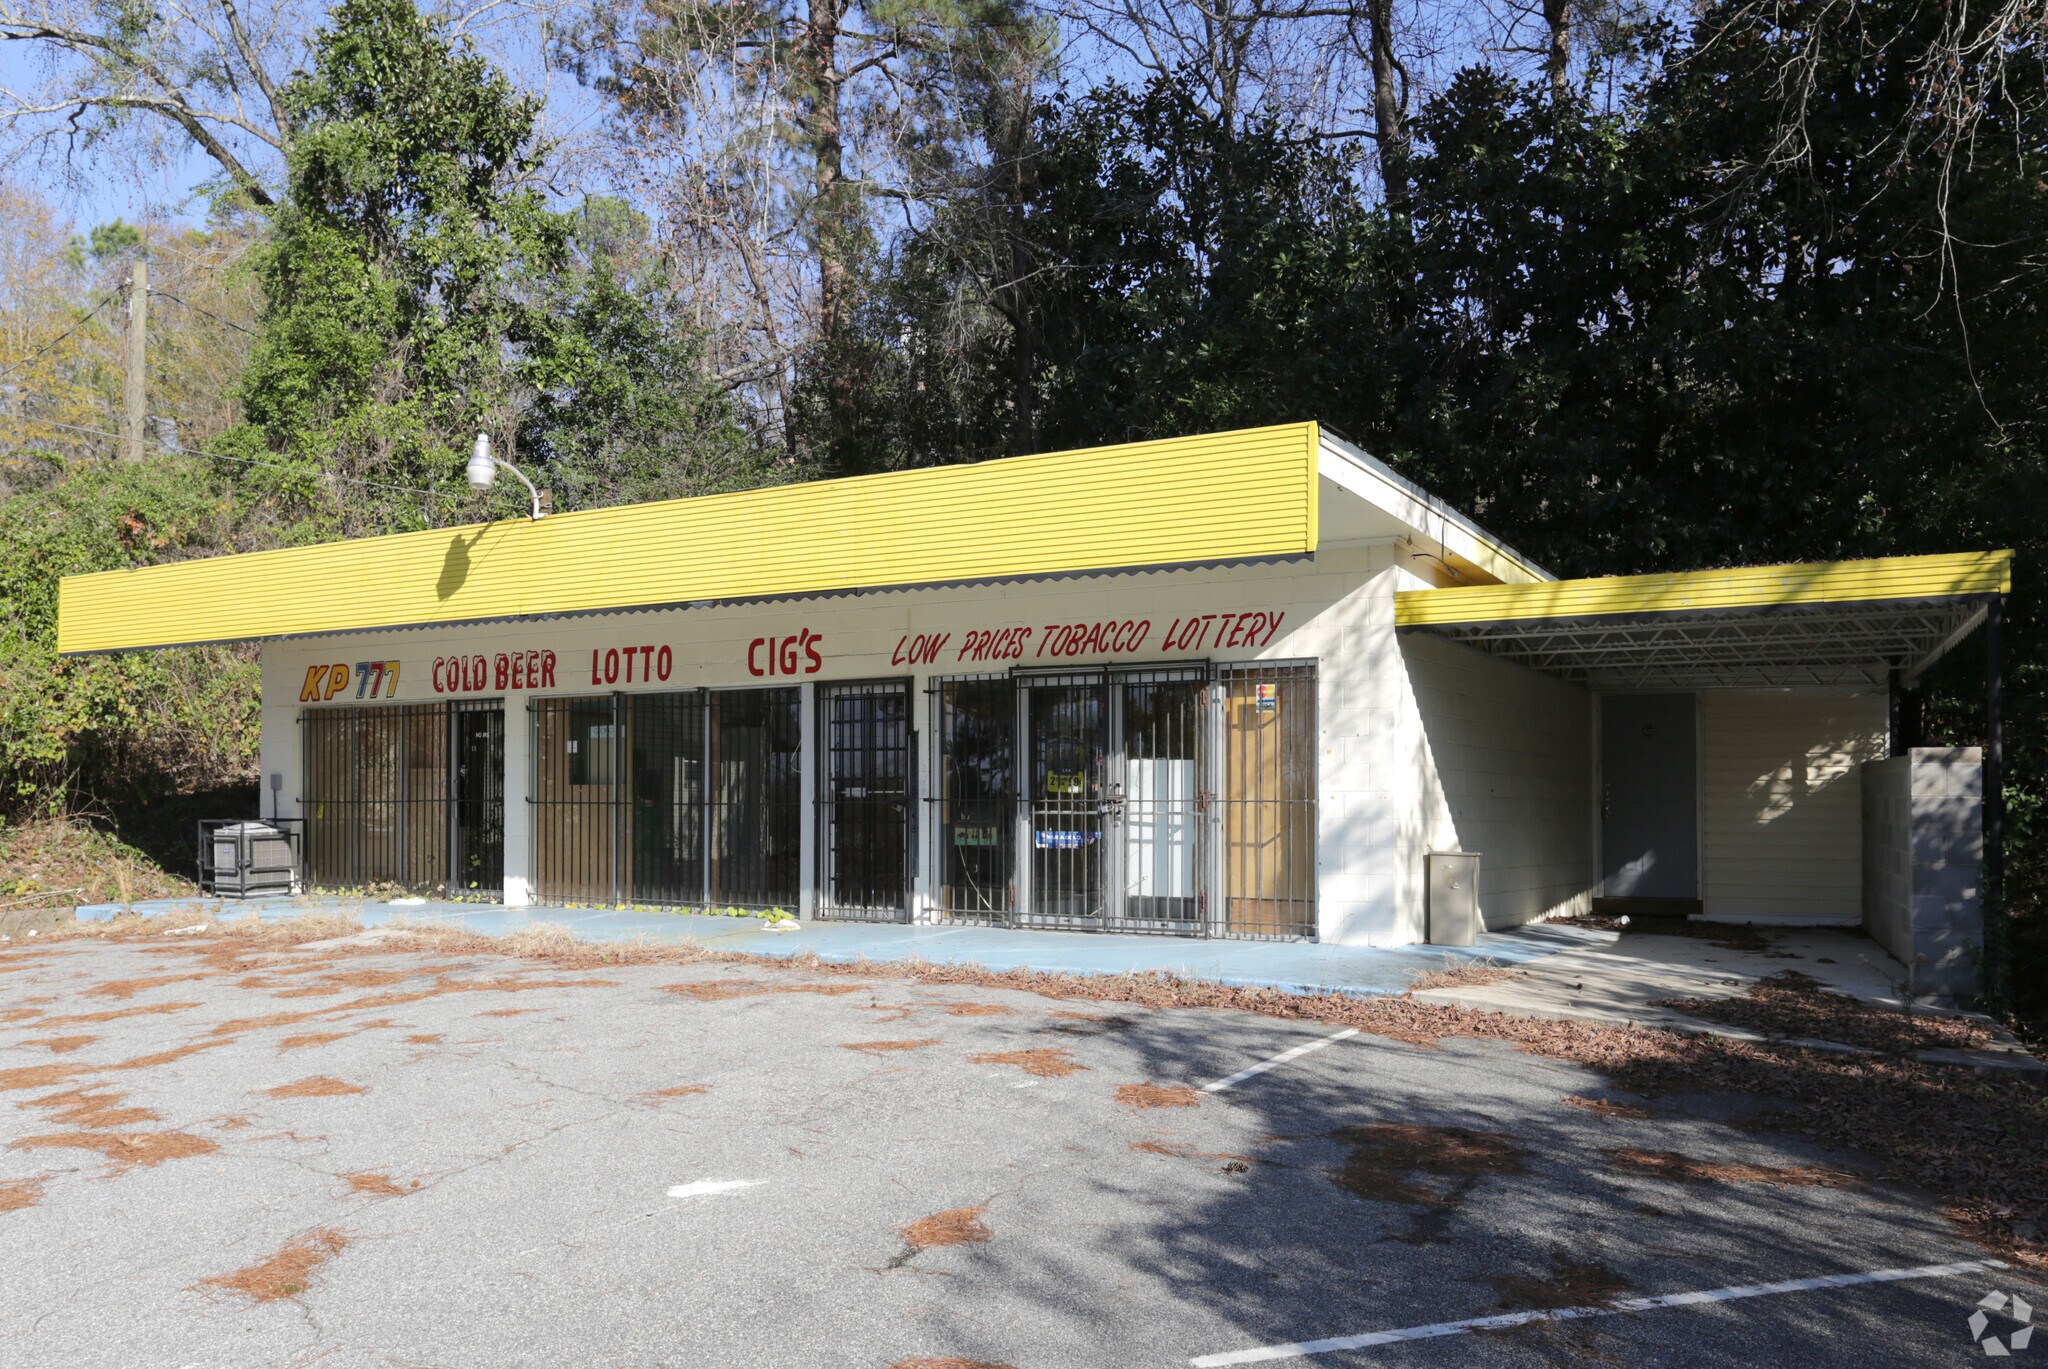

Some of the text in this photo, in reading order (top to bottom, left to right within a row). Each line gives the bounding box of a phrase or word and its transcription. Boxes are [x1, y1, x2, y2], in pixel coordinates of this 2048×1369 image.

[748, 628, 822, 676] CIG'S
[891, 611, 1285, 667] LOW PRICES TOBACCO LOTTERY
[300, 660, 400, 702] KP 777
[432, 649, 557, 693] COLD BEER
[592, 645, 672, 685] LOTTO
